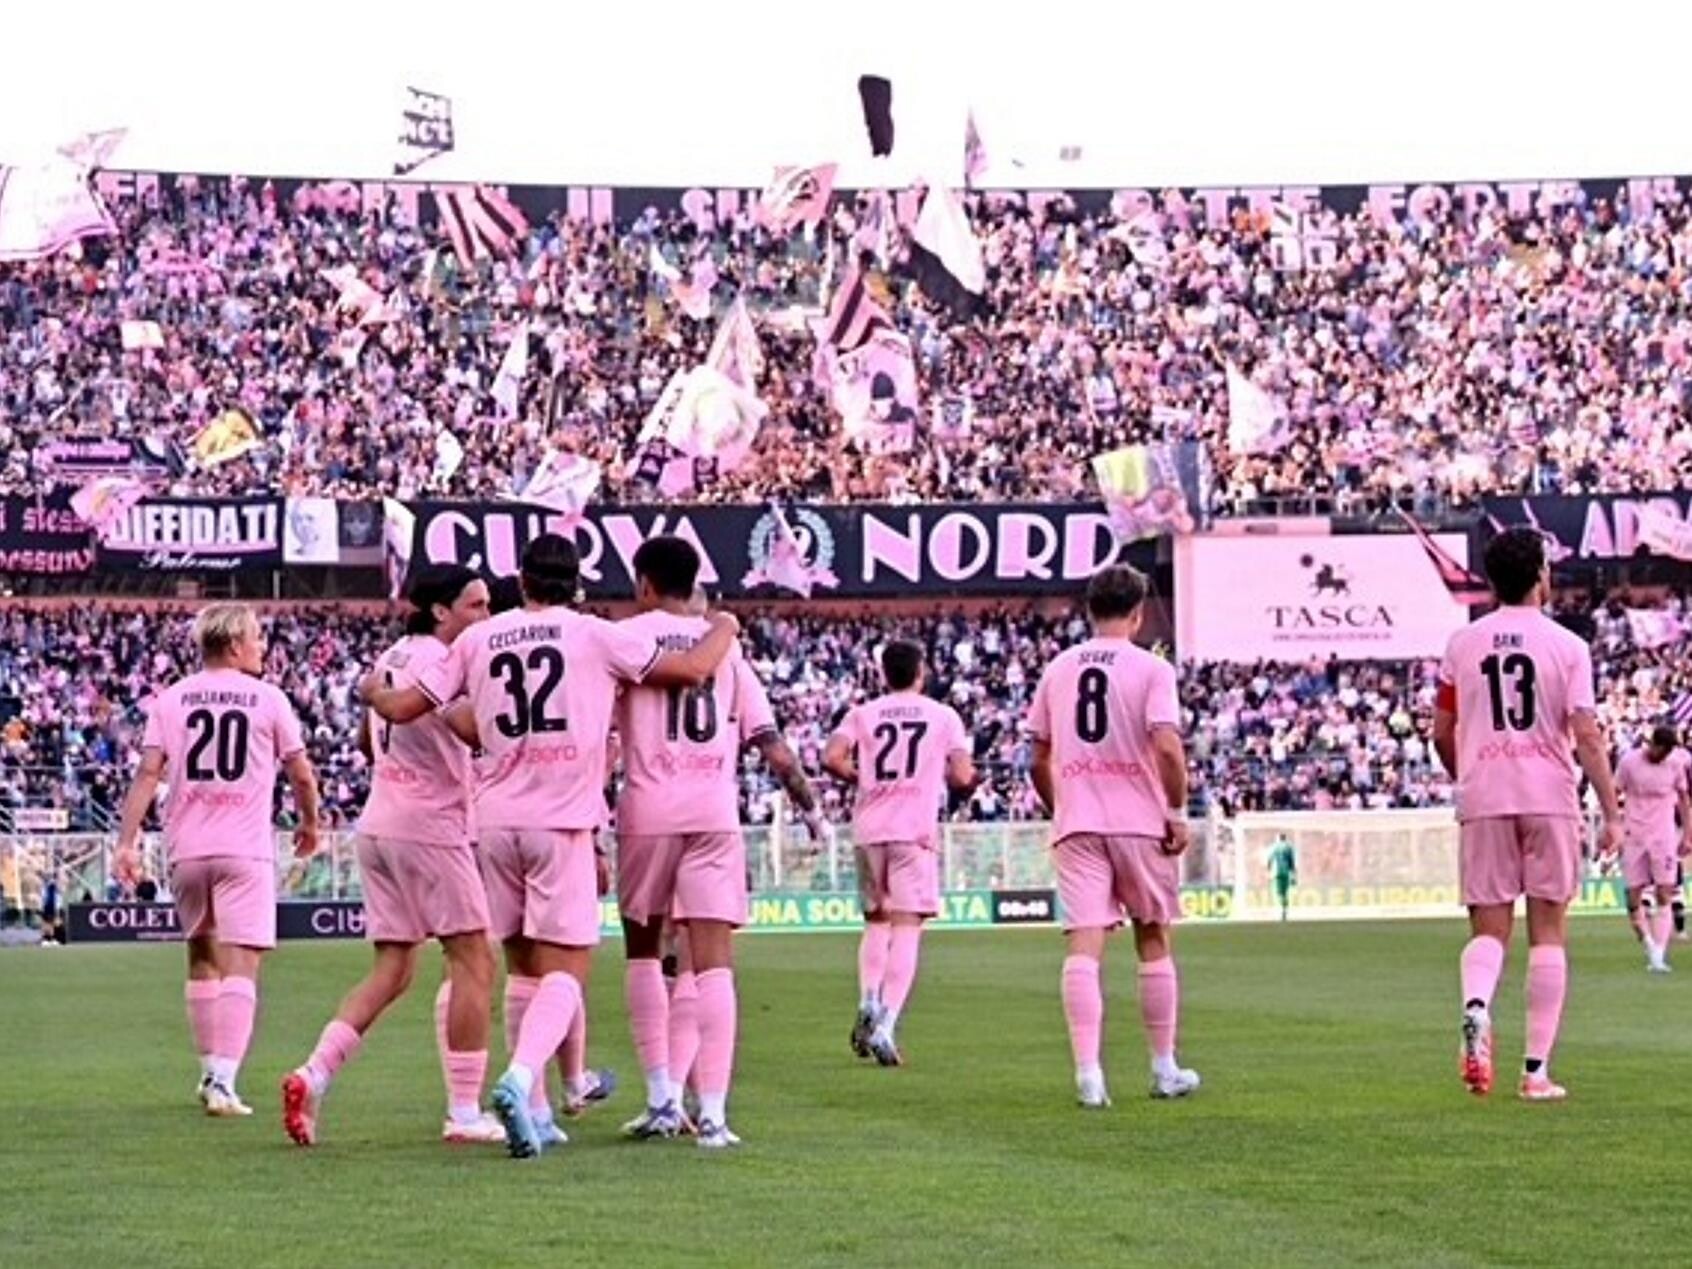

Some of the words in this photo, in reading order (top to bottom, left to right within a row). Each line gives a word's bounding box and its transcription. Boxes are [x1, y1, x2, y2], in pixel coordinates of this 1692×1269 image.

[424, 510, 719, 583] CURVA
[862, 512, 1121, 584] NORD
[488, 623, 562, 651] CECCARONI
[1265, 604, 1394, 628] TASCA
[489, 645, 568, 739] 32
[1075, 666, 1110, 744] 8
[1480, 653, 1536, 732] 13
[185, 708, 248, 782] 20
[873, 720, 928, 782] 27
